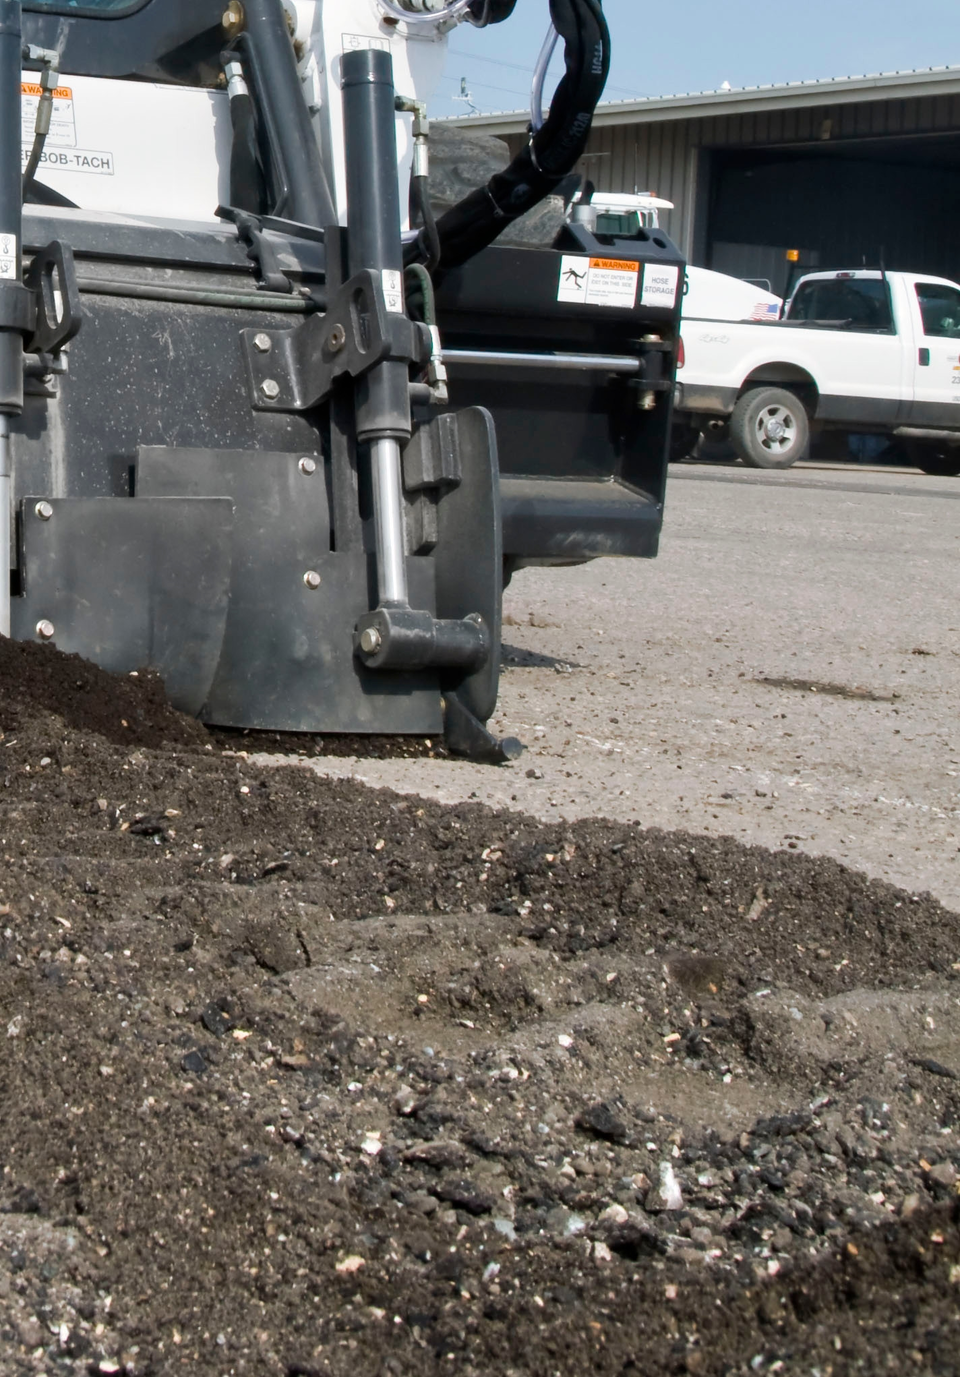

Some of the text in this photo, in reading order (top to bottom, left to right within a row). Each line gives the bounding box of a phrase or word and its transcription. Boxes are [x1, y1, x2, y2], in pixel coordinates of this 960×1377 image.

[27, 85, 68, 97] WAING
[40, 151, 110, 169] BOB-TACH
[601, 260, 636, 270] WARNING
[644, 286, 674, 294] STORAGE
